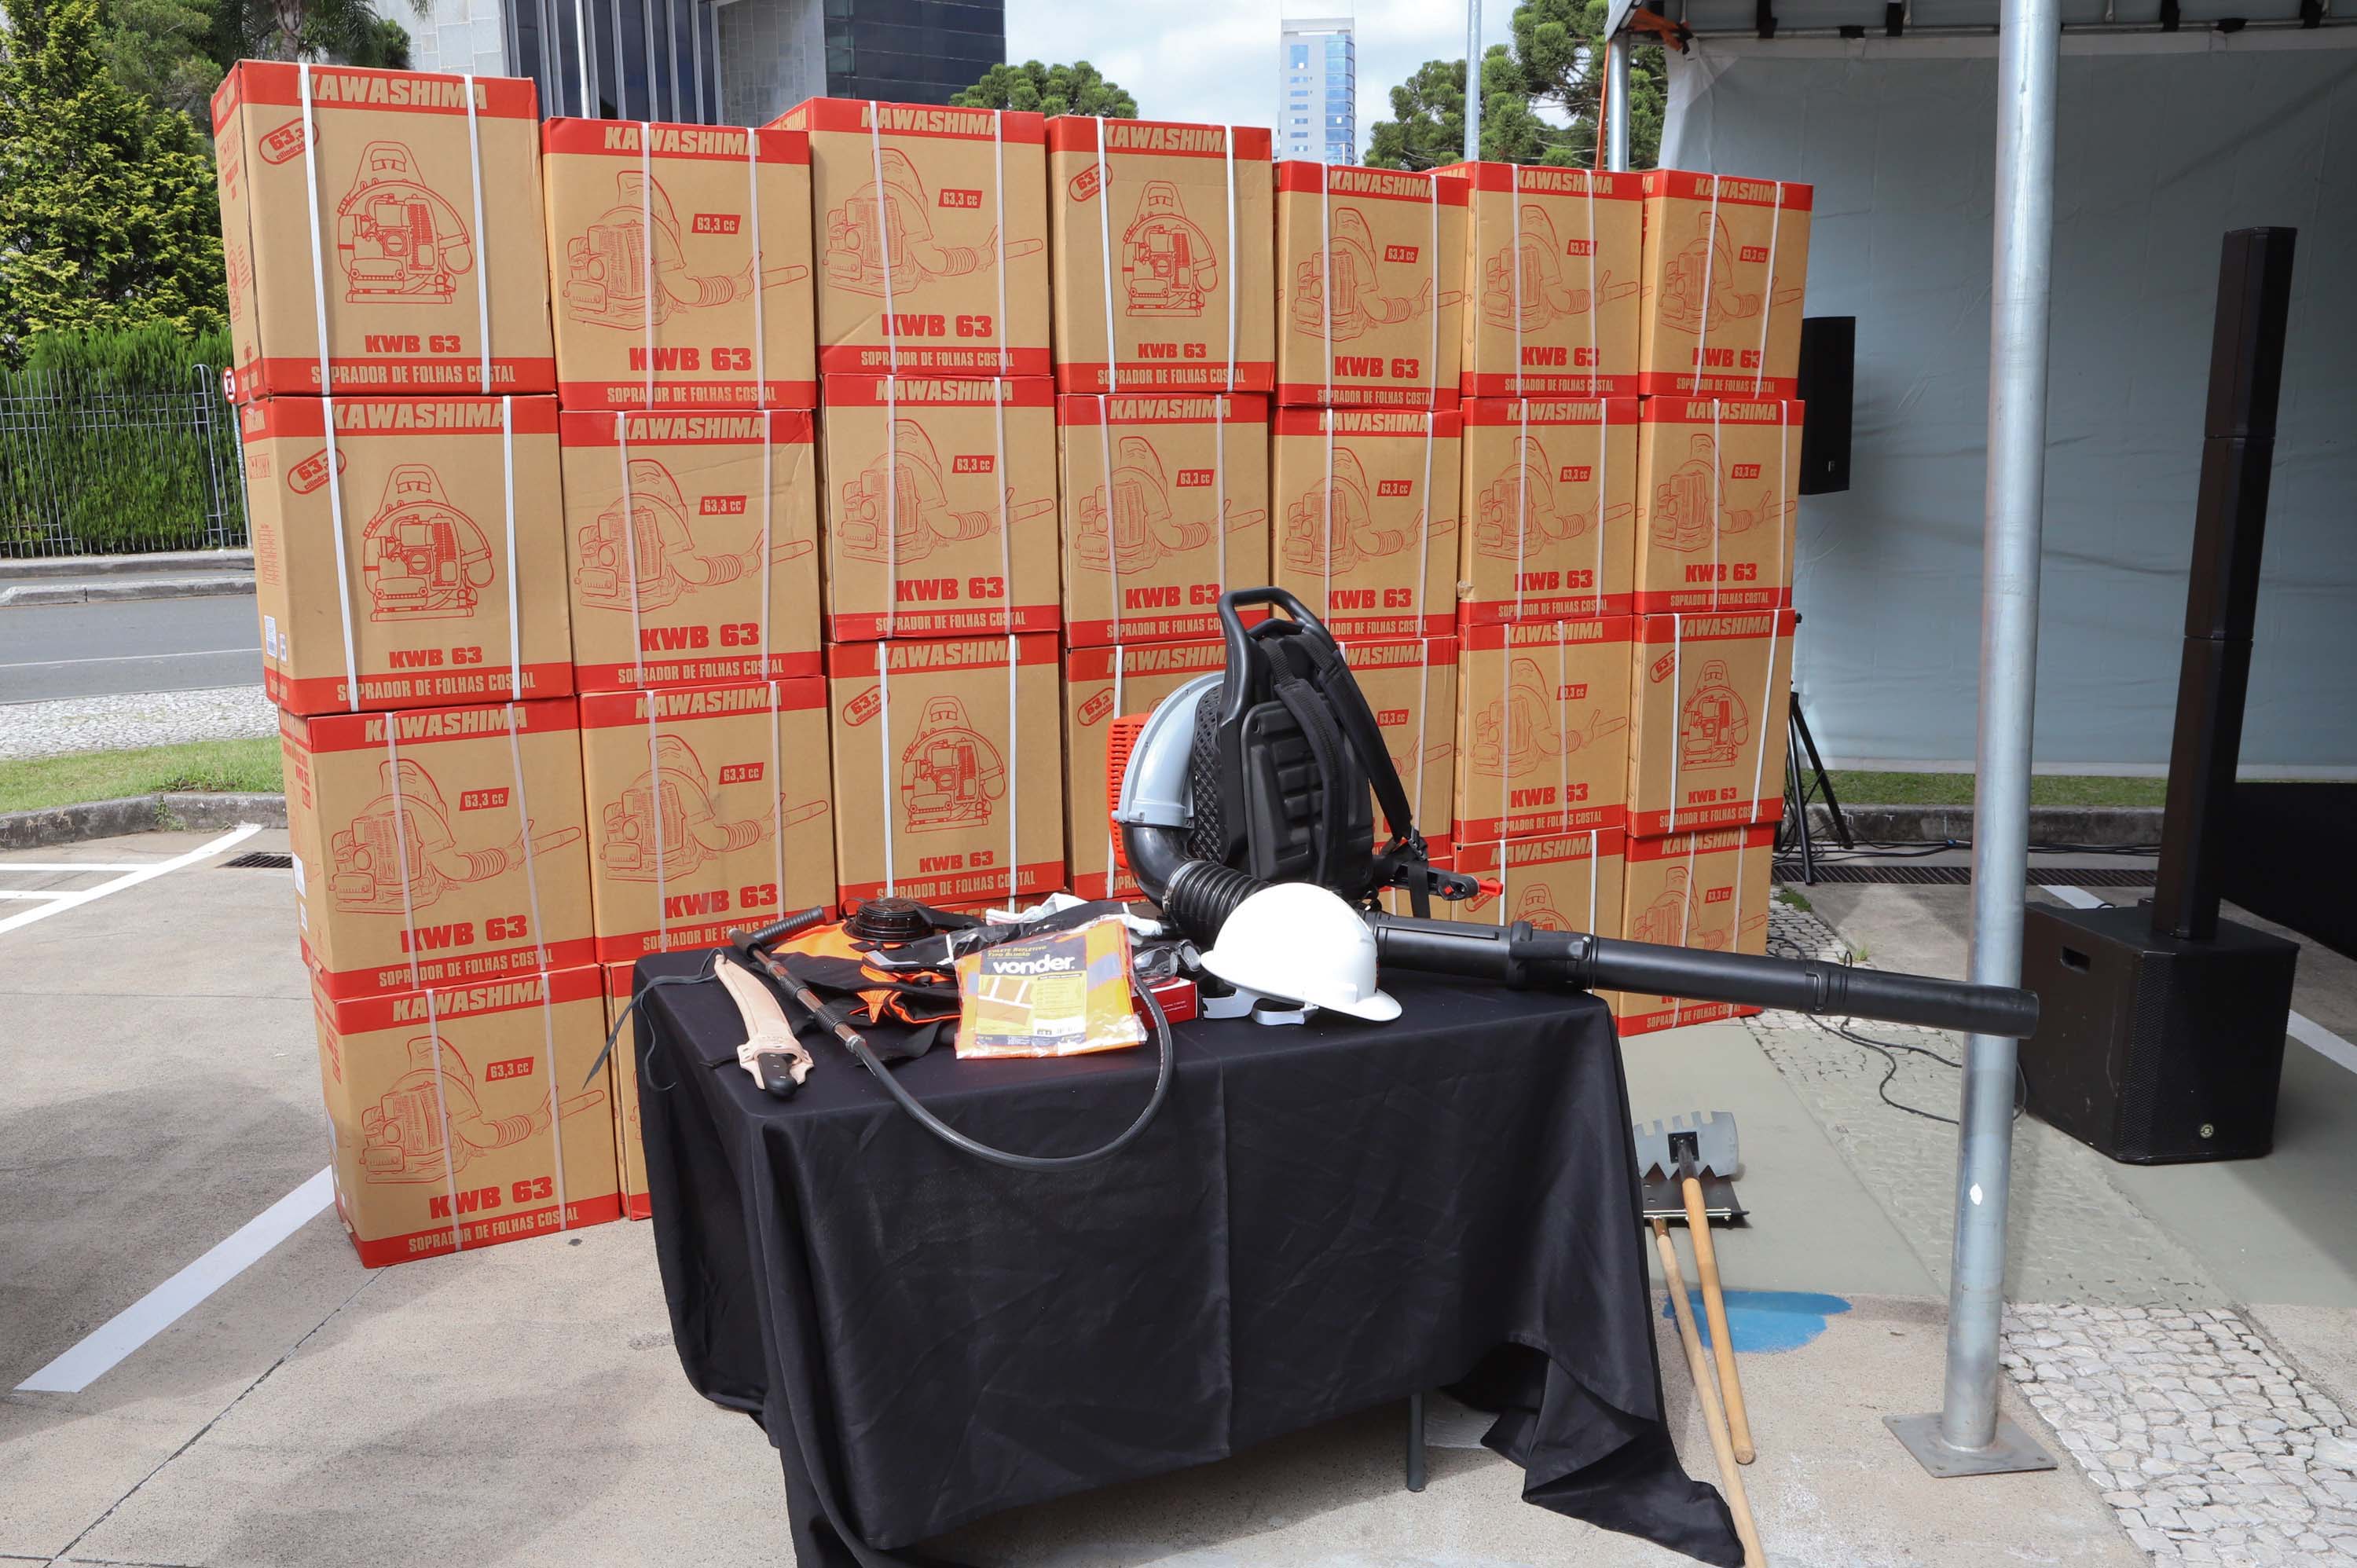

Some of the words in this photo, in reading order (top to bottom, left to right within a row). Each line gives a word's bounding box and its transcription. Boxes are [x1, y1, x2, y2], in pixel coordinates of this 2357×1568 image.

[944, 192, 964, 207] 63,3
[697, 218, 720, 233] 63,3
[882, 314, 945, 336] KWB
[956, 315, 992, 337] 63
[365, 335, 420, 352] KWB
[429, 335, 461, 353] 63
[1138, 343, 1178, 358] KWB
[1183, 343, 1207, 358] 63
[629, 347, 700, 371] KWB
[711, 347, 752, 371] 63
[860, 352, 917, 366] SOPRDOR
[921, 352, 933, 366] DE
[937, 352, 973, 367] FOLHAS
[1521, 346, 1567, 366] KWB
[311, 365, 388, 383] SPRADOR
[392, 365, 409, 383] DE
[412, 365, 463, 383] FOLHAS
[1157, 369, 1168, 383] DE
[1171, 369, 1207, 383] FOLHAS
[1210, 369, 1245, 383] COSAL
[1335, 356, 1383, 376] KWB
[1391, 358, 1419, 378] 63
[1505, 379, 1545, 391] SORADOR
[1548, 379, 1557, 391] DE
[1559, 379, 1585, 392] FOLHAS
[1587, 380, 1614, 392] CSTAL
[1677, 378, 1712, 390] SOPRDOR
[607, 387, 669, 402] SOPRAOR
[673, 387, 687, 401] DE
[691, 387, 732, 401] FOLHAS
[735, 387, 776, 401] COSAL
[1363, 391, 1373, 403] DE
[1376, 391, 1403, 404] FOLHAS
[1406, 393, 1431, 405] COSTA
[957, 458, 976, 471] 63,3
[1181, 473, 1198, 485] 63,3
[705, 500, 727, 514] 63,3
[1567, 570, 1592, 589] 63
[1685, 564, 1726, 582] KWB
[1733, 563, 1756, 581] 63
[896, 579, 958, 602] KWB
[969, 577, 1003, 599] 63
[1125, 586, 1180, 610] KWB
[1190, 584, 1219, 606] 63
[1384, 588, 1412, 608] 63
[1541, 602, 1549, 614] DE
[1552, 599, 1578, 614] FOLHAS
[935, 615, 945, 628] DE
[949, 613, 985, 628] FOLHAS
[1160, 621, 1170, 635] DE
[1173, 618, 1204, 633] FOLHAS
[1355, 621, 1365, 634] DE
[1368, 619, 1395, 633] FOLHAS
[640, 626, 709, 652] KWB
[720, 623, 758, 647] 63
[389, 650, 443, 668] KWB
[452, 647, 482, 665] 63
[1346, 645, 1423, 665] WASHIMA
[683, 665, 695, 679] DE
[700, 661, 739, 677] FOLHAS
[337, 680, 411, 702] SPRADOR
[415, 680, 431, 696] DE
[435, 675, 484, 694] FOLHAS
[489, 672, 536, 690] COSAL
[724, 768, 745, 782] 63,3
[464, 793, 489, 808] 63,3
[1510, 787, 1556, 808] KWB
[1689, 790, 1716, 804] KWB
[1721, 788, 1736, 800] 63
[1537, 817, 1545, 828] DE
[1576, 811, 1601, 823] COSTAL
[1700, 811, 1709, 823] DE
[1710, 808, 1736, 822] FOLHAS
[919, 855, 962, 873] KWB
[970, 851, 993, 866] 63
[877, 882, 936, 899] SPRADOR
[940, 881, 952, 895] DE
[956, 875, 994, 893] FOLHAS
[998, 870, 1036, 888] COTAL
[665, 890, 729, 918] KWB
[740, 884, 777, 908] 63
[401, 922, 474, 953] KWB
[486, 915, 527, 941] 63
[705, 928, 717, 941] DE
[379, 964, 442, 987] SOPRDOR
[447, 962, 461, 976] DE
[465, 955, 508, 974] FOLHAS
[490, 1063, 514, 1079] 63,3
[430, 1186, 501, 1219] KWB
[512, 1176, 552, 1203] 63
[475, 1225, 489, 1239] DE
[493, 1218, 534, 1236] FOLHAS
[537, 1207, 579, 1226] COSAL
